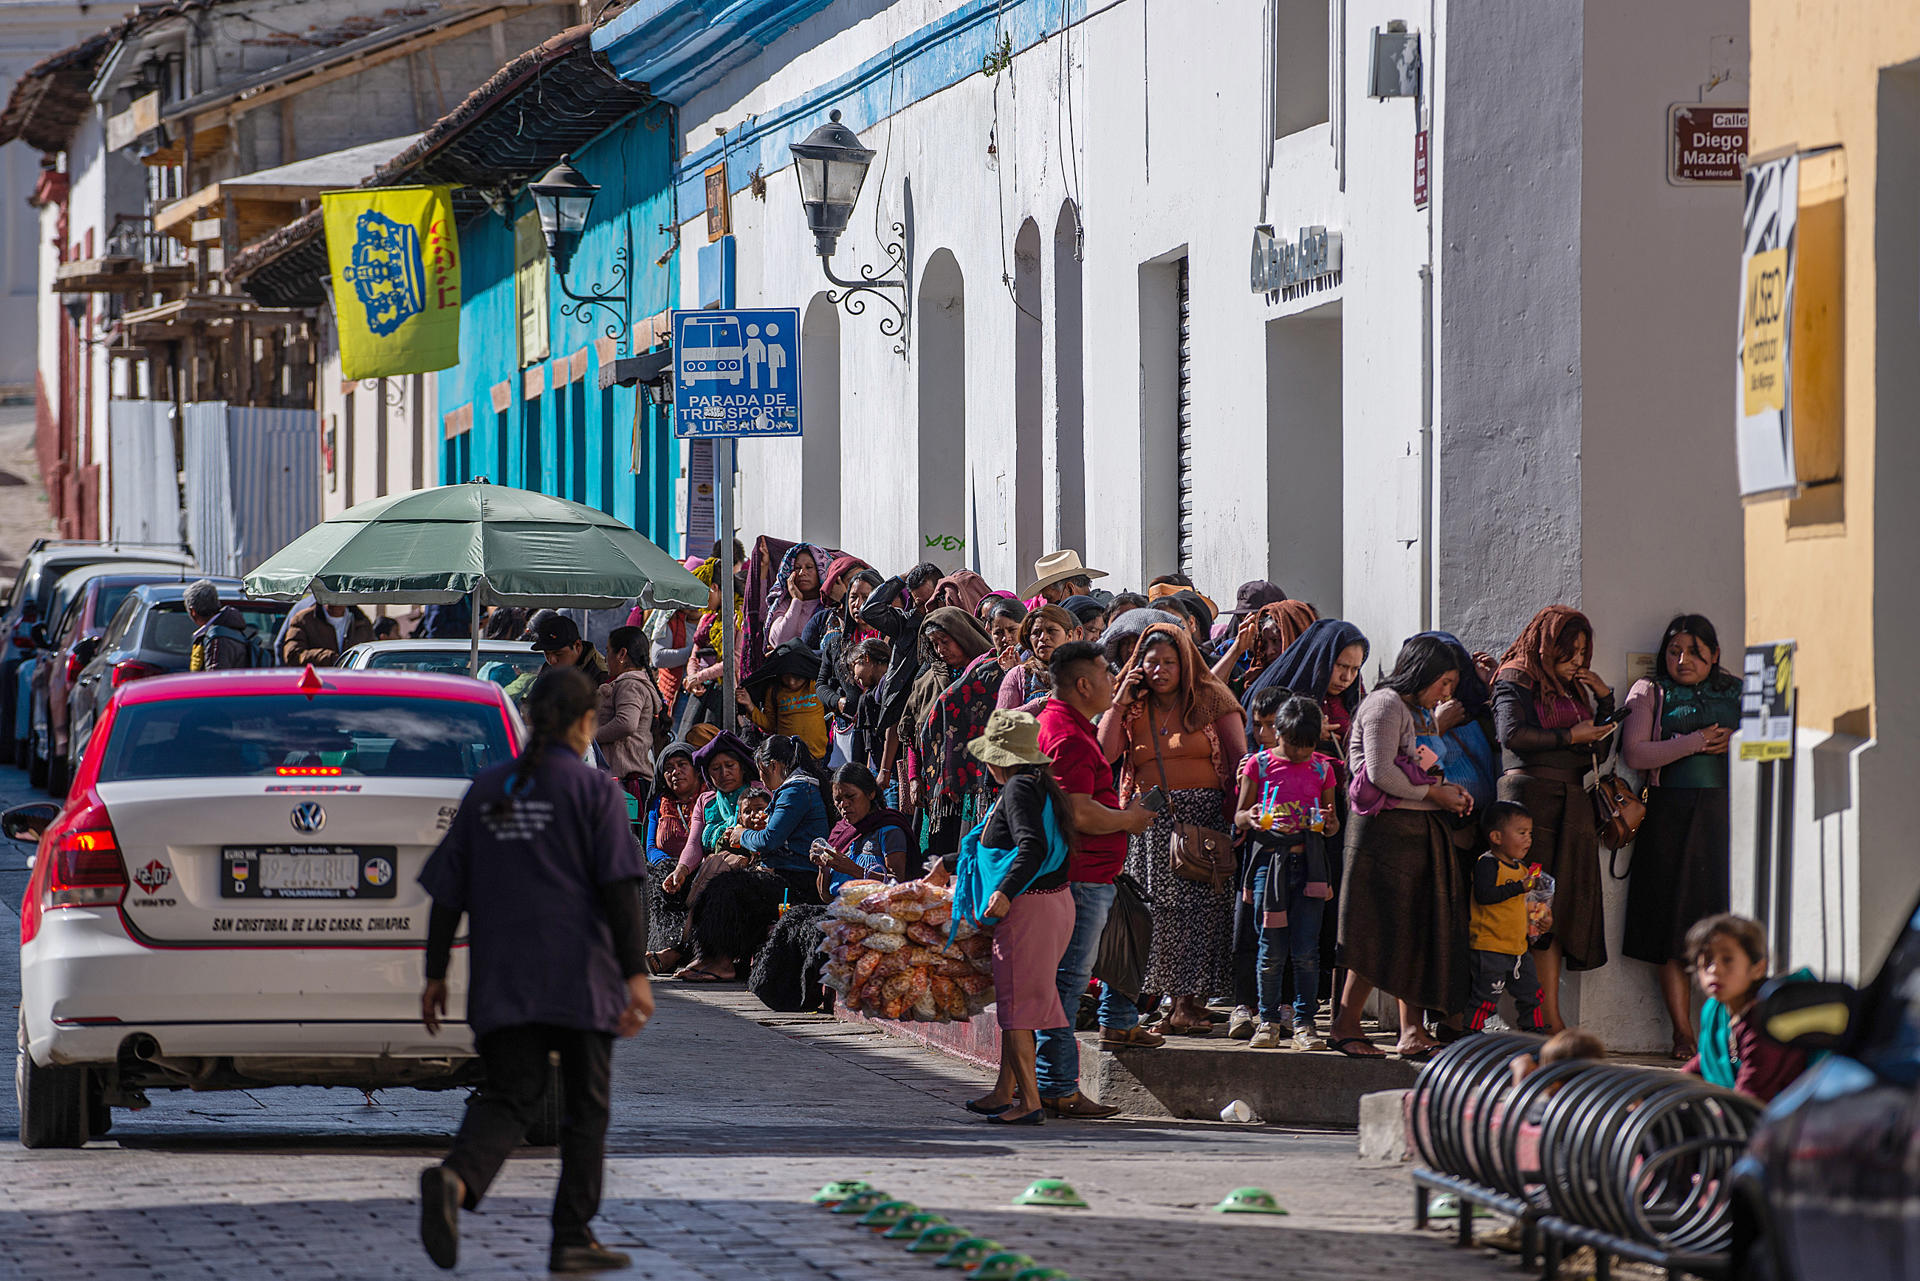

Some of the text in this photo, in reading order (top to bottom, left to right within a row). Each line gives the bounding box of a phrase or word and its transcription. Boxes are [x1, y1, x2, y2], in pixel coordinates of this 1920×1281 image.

[1715, 115, 1747, 126] Calle
[1693, 132, 1743, 151] Diego
[1694, 169, 1703, 177] La
[1705, 169, 1733, 177] Merced
[689, 393, 787, 407] PARADA DE
[680, 406, 796, 420] TRSPORTE
[235, 881, 246, 893] D
[133, 898, 177, 907] VENTO
[212, 917, 411, 932] SAN CRISTOBAL DE LAS CASAS, CHIAPAS.
